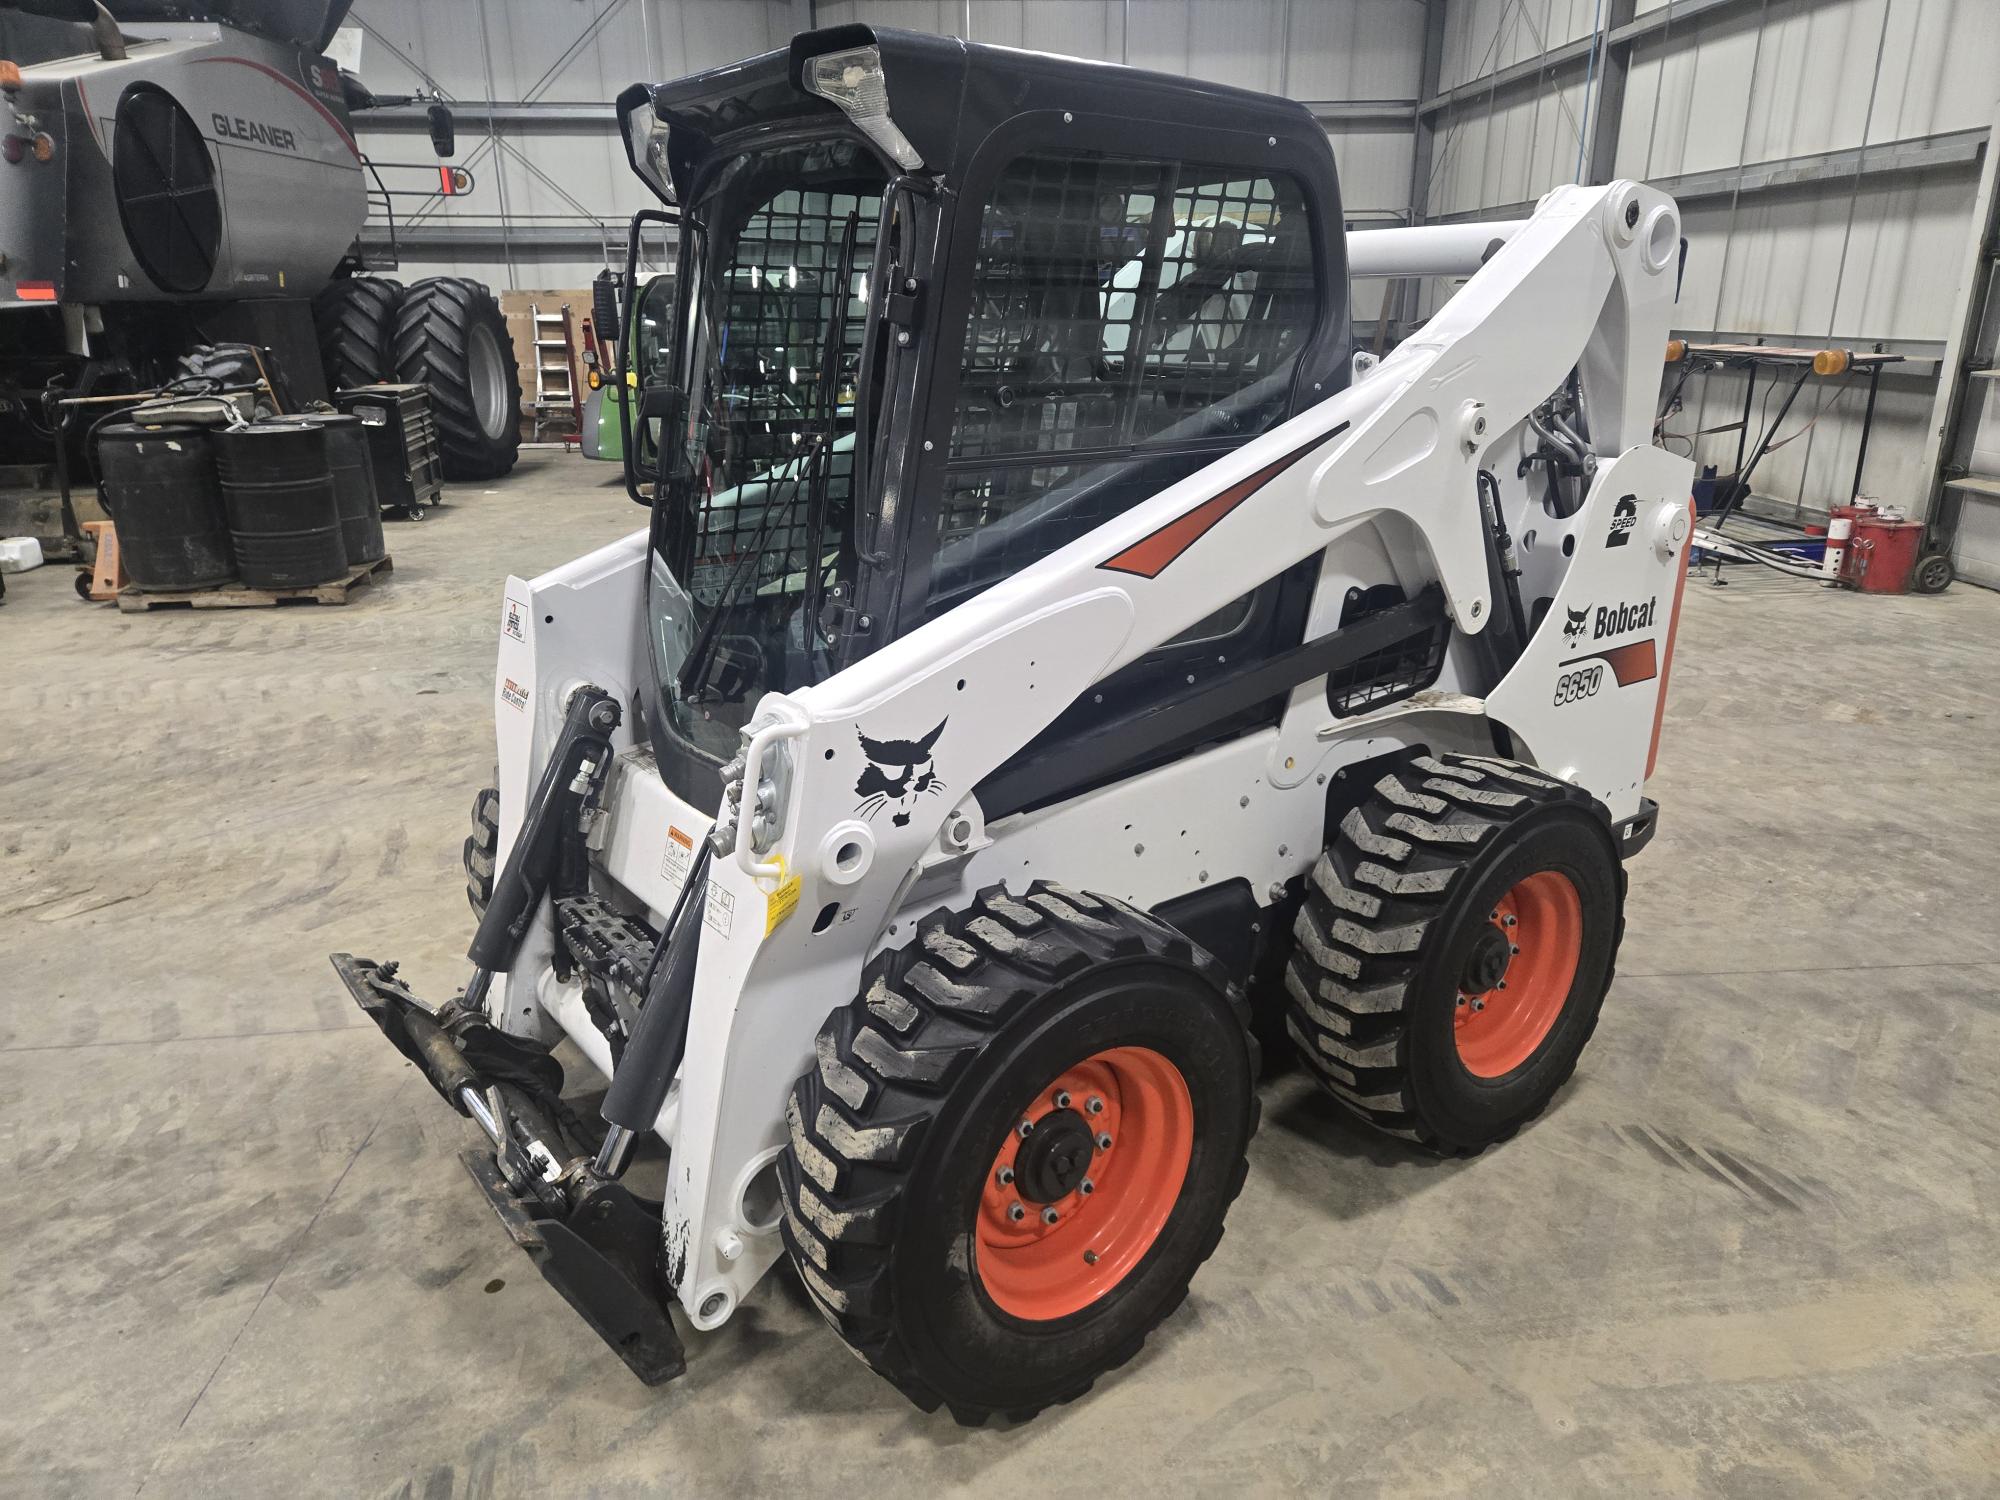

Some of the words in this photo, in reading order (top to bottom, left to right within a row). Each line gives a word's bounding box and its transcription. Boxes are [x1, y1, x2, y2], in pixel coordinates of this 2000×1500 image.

[212, 113, 296, 151] GLEANER
[1605, 494, 1637, 548] 2
[1610, 517, 1637, 530] SPEED
[1593, 596, 1656, 640] Bobcat
[1554, 665, 1603, 707] S650
